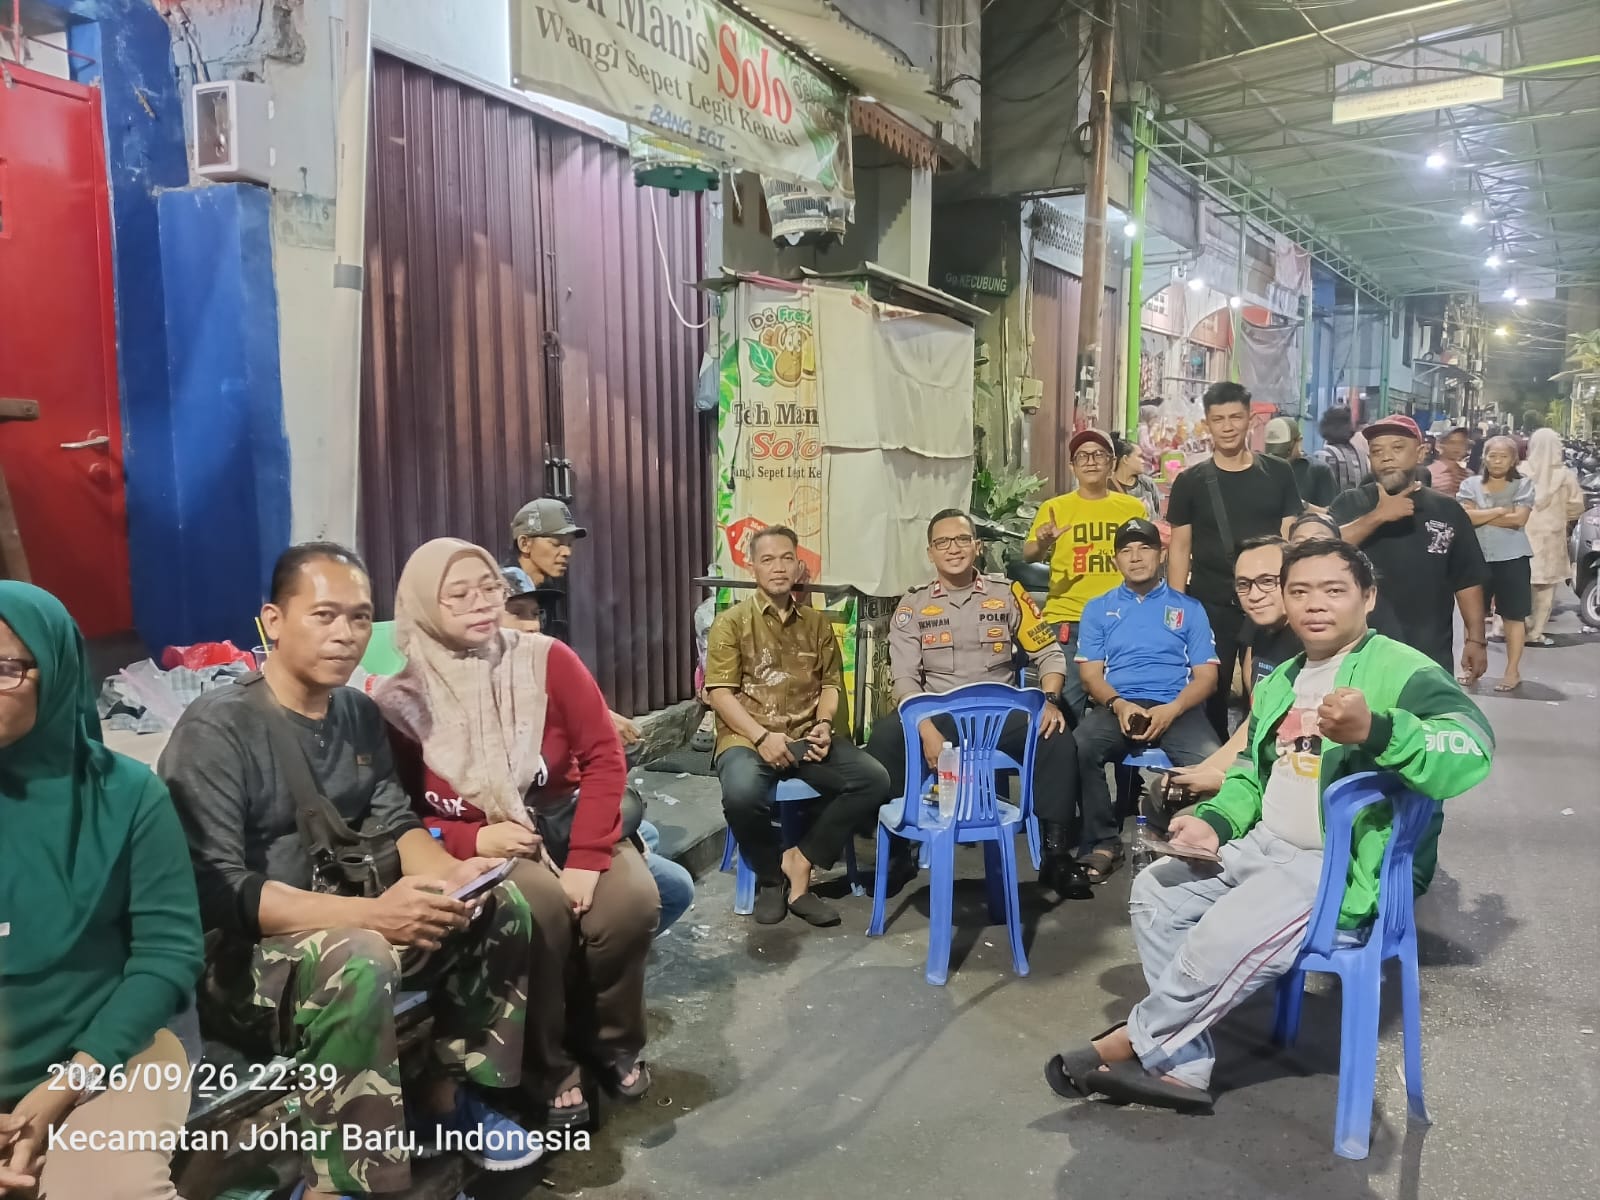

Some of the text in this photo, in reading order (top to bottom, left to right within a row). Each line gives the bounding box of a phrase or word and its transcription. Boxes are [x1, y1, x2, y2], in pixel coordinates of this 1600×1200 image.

[535, 6, 800, 147] Wangi Sepet Legit Kental
[616, 0, 793, 125] Manis Solo
[649, 104, 693, 138] BANG
[734, 403, 819, 425] Teh Man
[752, 431, 821, 459] Solo
[757, 466, 784, 480] Sepet
[979, 613, 1009, 622] POLRI
